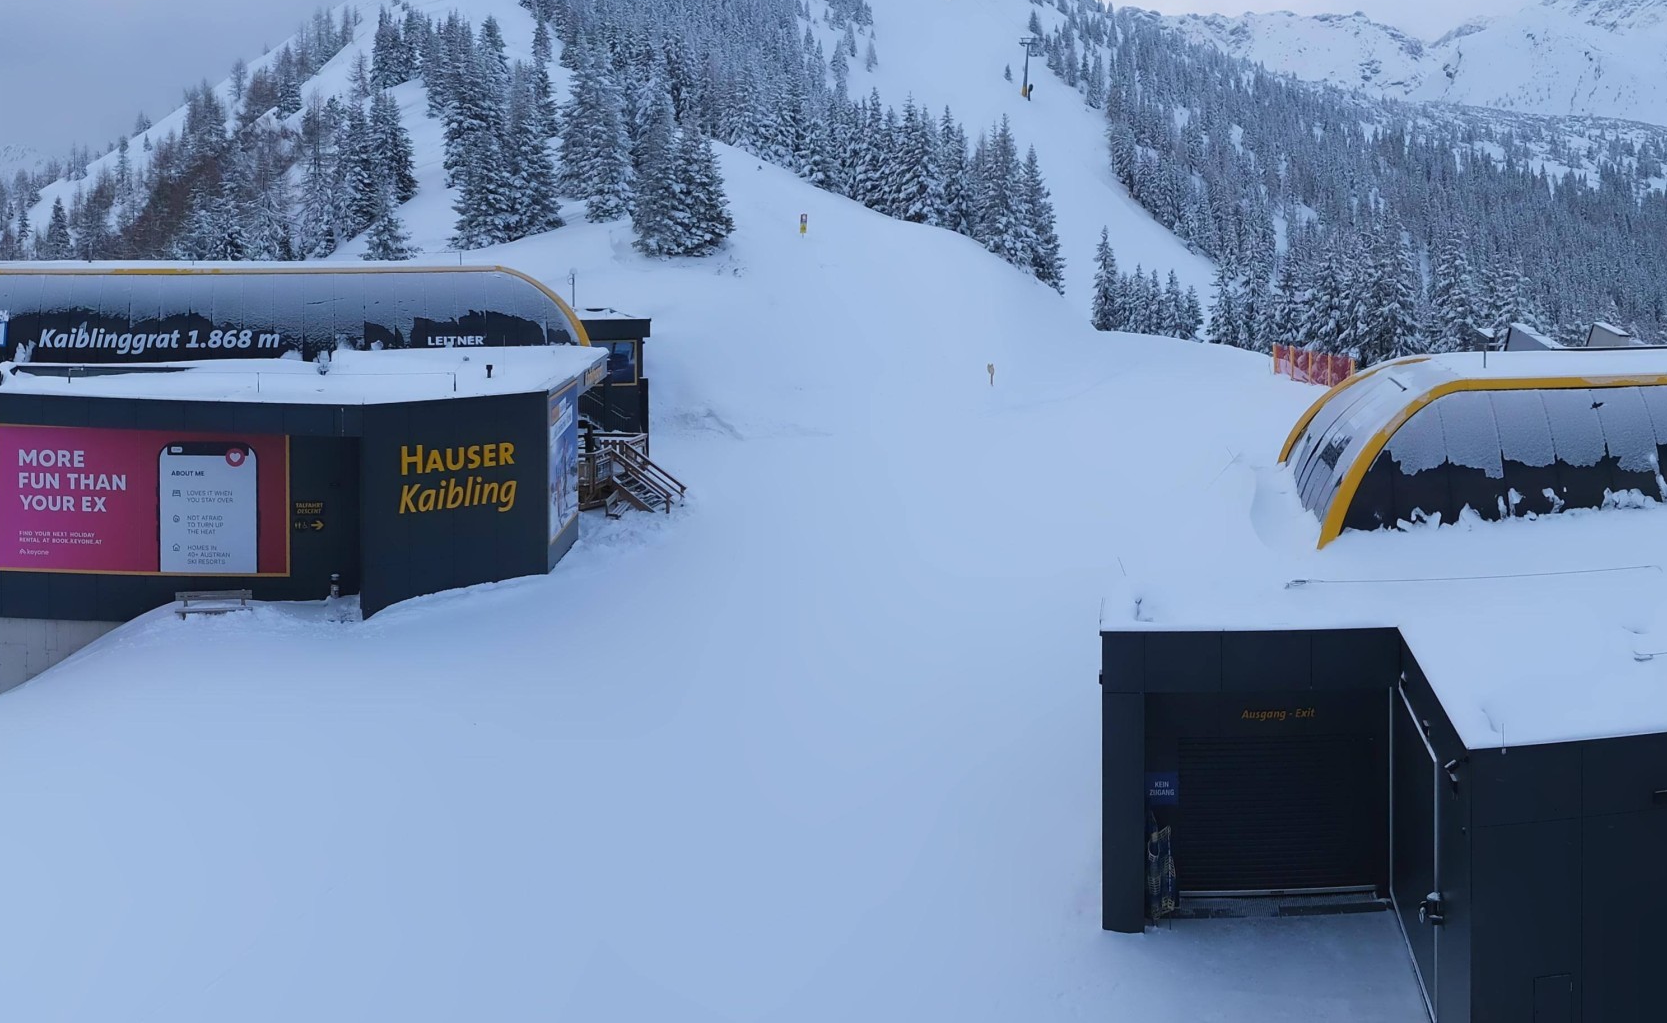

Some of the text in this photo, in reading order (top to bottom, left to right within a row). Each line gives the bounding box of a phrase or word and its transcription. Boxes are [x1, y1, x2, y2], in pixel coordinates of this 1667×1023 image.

[38, 328, 280, 354] Kaiblinggrat 1.868 m
[427, 336, 484, 346] LEITNER
[18, 449, 85, 468] MORE
[401, 442, 515, 475] HAUSER
[18, 472, 126, 491] FUN THAN
[20, 494, 107, 512] YOUR EX
[399, 476, 517, 514] Kaibling
[1241, 709, 1286, 721] Ausgang
[1295, 708, 1316, 718] Exit
